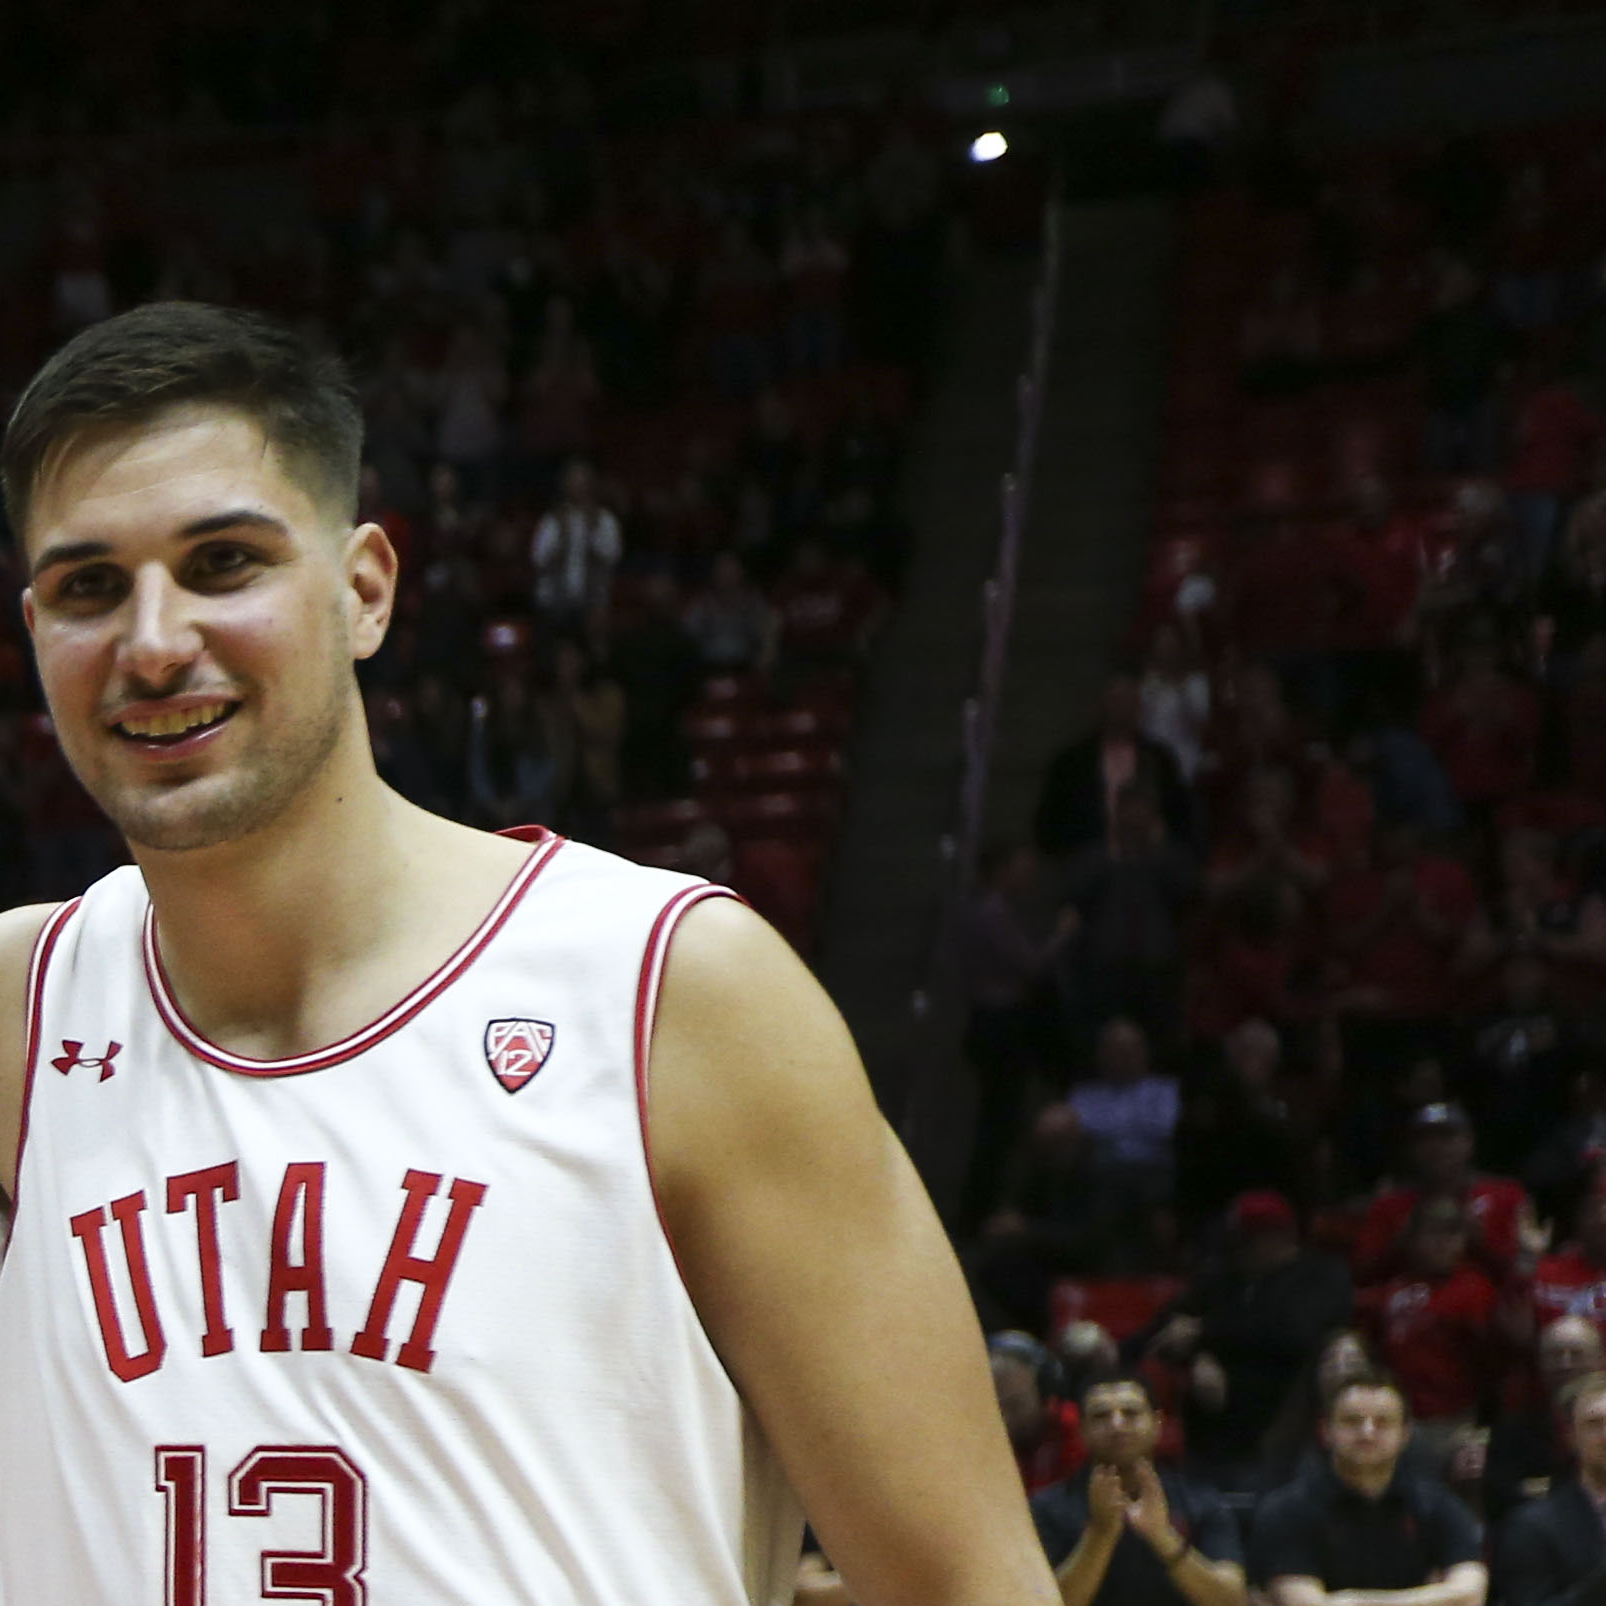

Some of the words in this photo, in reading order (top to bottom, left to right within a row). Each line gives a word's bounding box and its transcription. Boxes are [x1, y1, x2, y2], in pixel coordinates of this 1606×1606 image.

[487, 1021, 553, 1063] PAC
[496, 1048, 534, 1077] 12
[69, 1159, 491, 1384] UTAH
